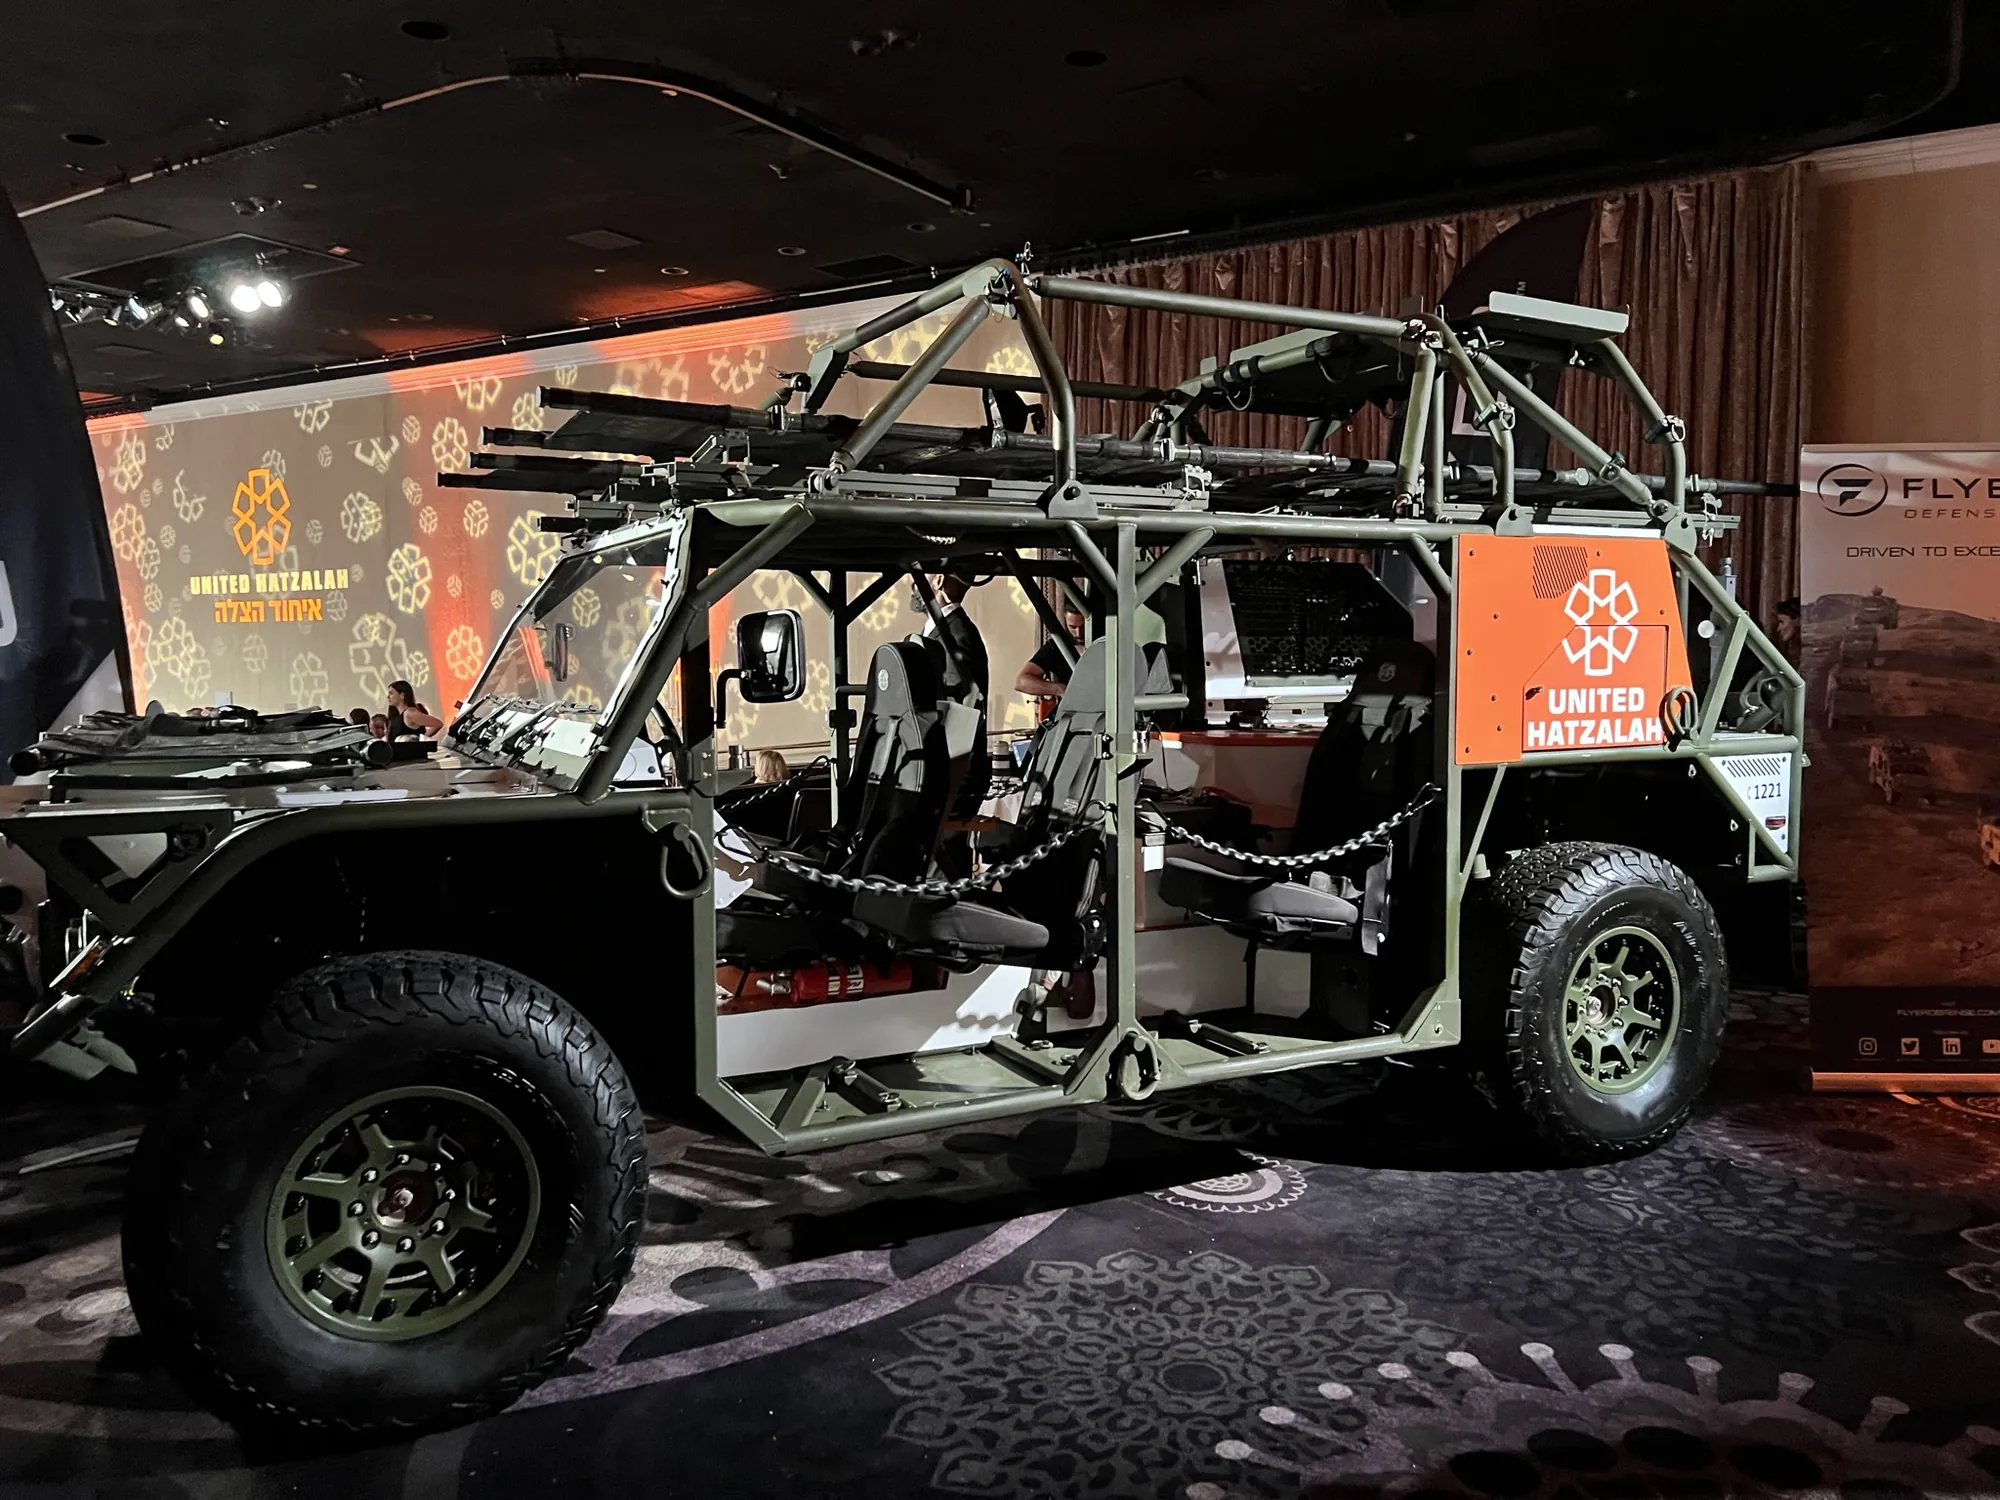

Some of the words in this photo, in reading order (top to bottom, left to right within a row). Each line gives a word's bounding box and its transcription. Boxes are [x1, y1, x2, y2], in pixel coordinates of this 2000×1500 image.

[1903, 478, 2000, 499] FLYE
[1847, 547, 1914, 557] DRIVEN
[1922, 546, 1947, 556] TO
[1954, 546, 2000, 556] EXCE
[190, 574, 250, 595] UNITED
[256, 569, 349, 593] HATZALAH
[214, 598, 265, 623] הצלה
[268, 598, 323, 622] איחוד
[1549, 687, 1645, 714] UNITED
[1527, 717, 1664, 747] HATZALAH
[1754, 782, 1782, 800] 1221
